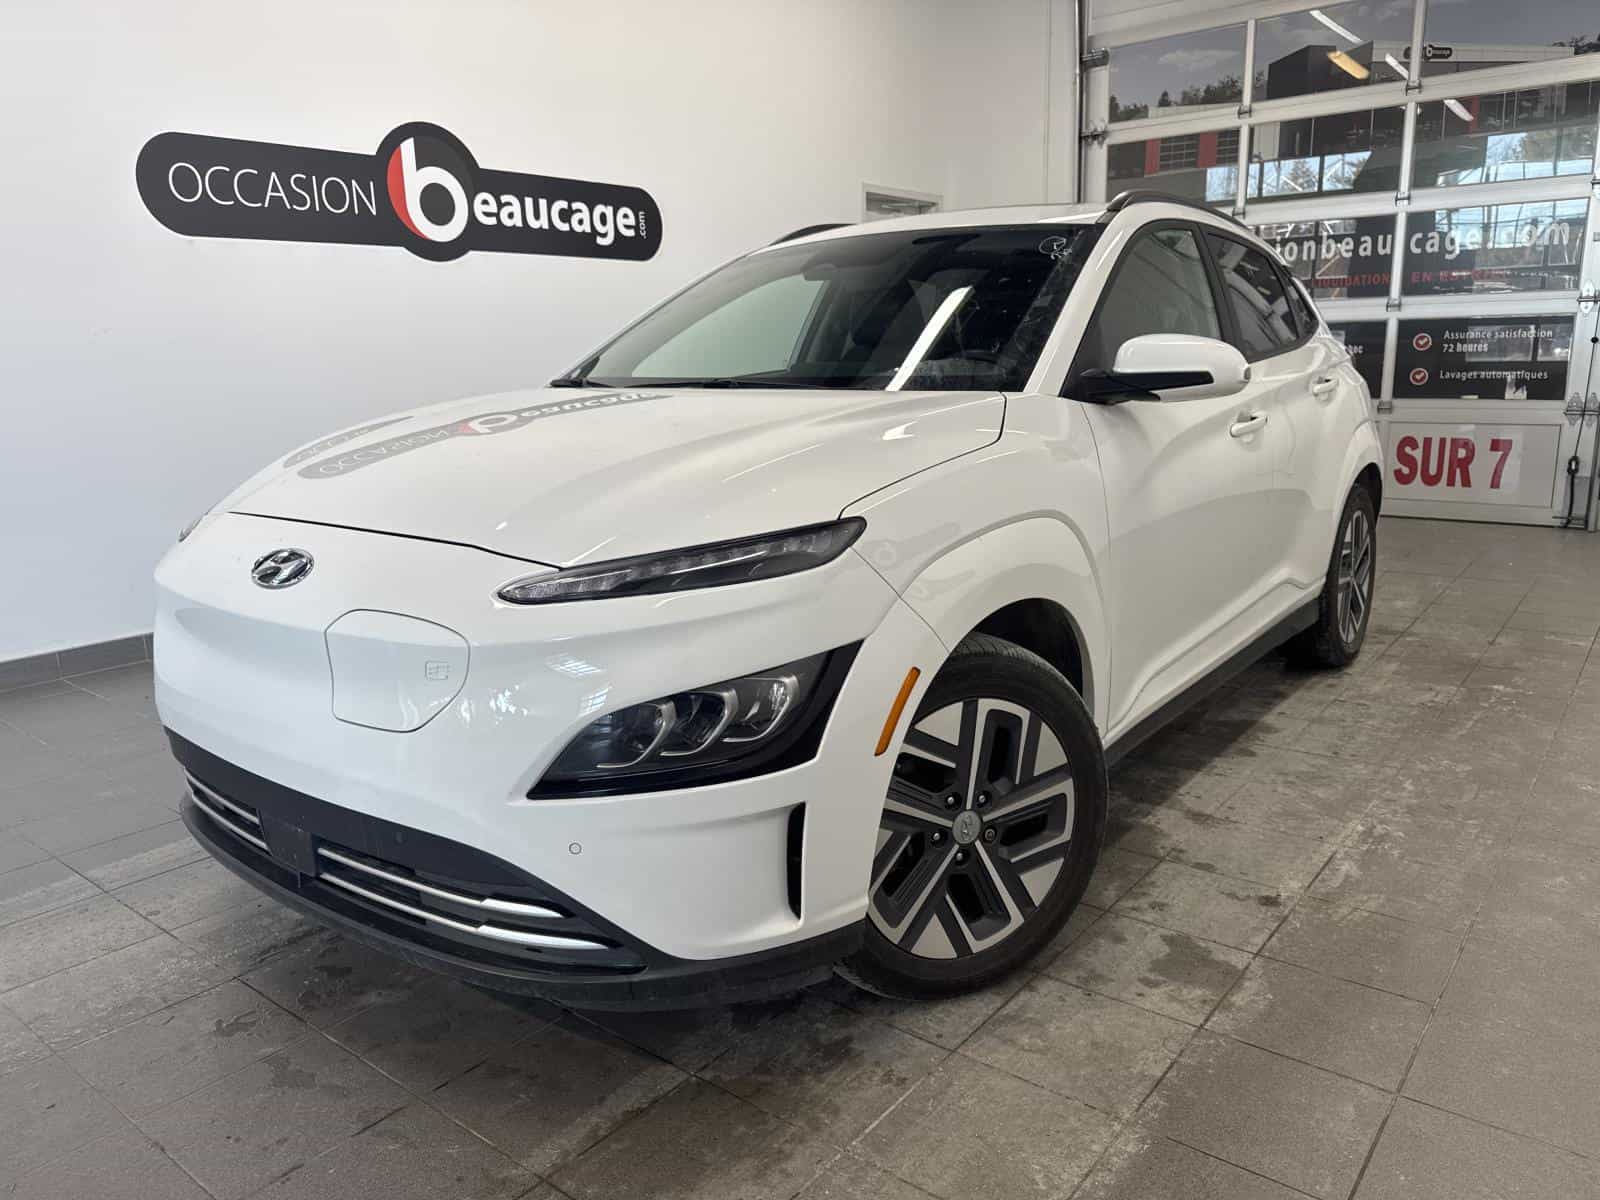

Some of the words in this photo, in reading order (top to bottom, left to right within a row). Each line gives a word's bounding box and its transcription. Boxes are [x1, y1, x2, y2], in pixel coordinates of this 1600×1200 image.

[168, 161, 377, 217] OCCASION
[400, 137, 636, 246] beaucage
[1443, 330, 1491, 340] Assurance
[1495, 328, 1553, 339] satisfaction
[1443, 343, 1454, 353] 72
[1456, 342, 1489, 353] heures
[1440, 369, 1477, 381] Lavages
[1480, 369, 1549, 380] automatiques
[1394, 435, 1476, 488] SUR
[1489, 438, 1513, 489] 7
